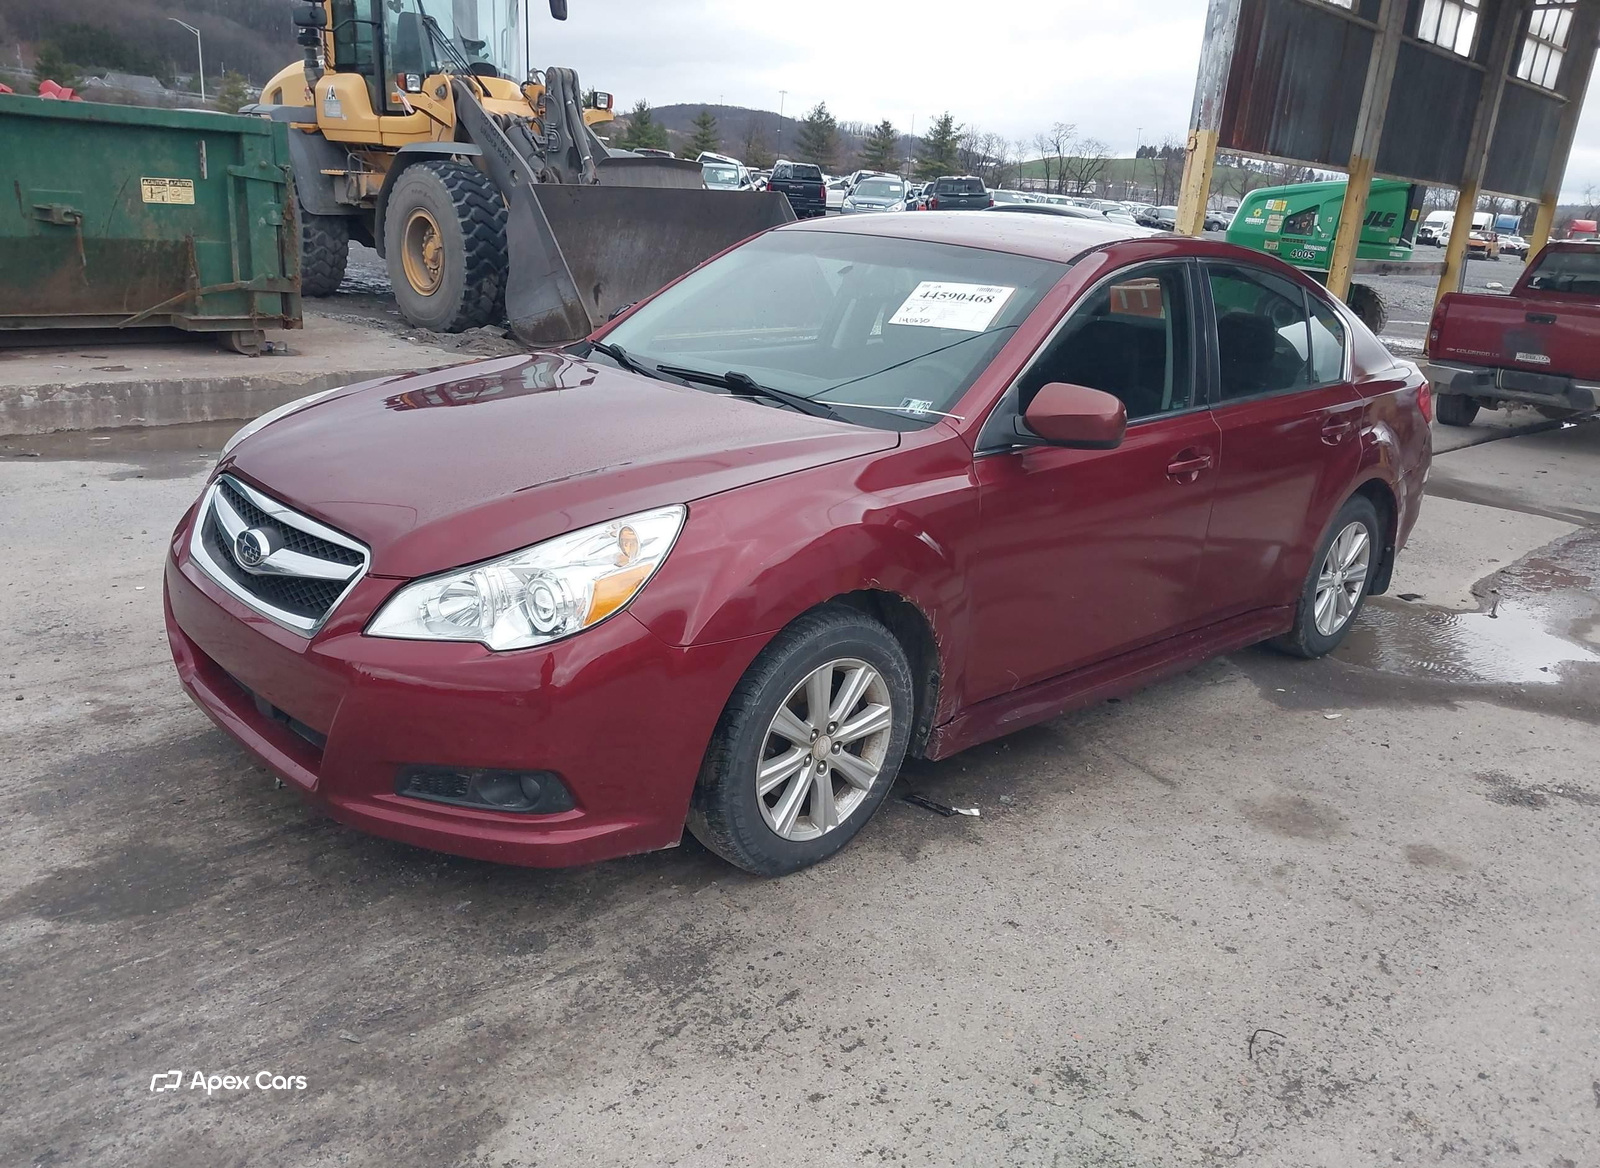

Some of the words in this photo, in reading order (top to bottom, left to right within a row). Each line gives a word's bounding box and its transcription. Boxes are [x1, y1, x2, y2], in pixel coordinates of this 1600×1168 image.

[1363, 211, 1397, 228] JLG
[1290, 249, 1316, 259] 400S
[919, 291, 995, 304] 44590468
[1456, 348, 1490, 357] COLORADO
